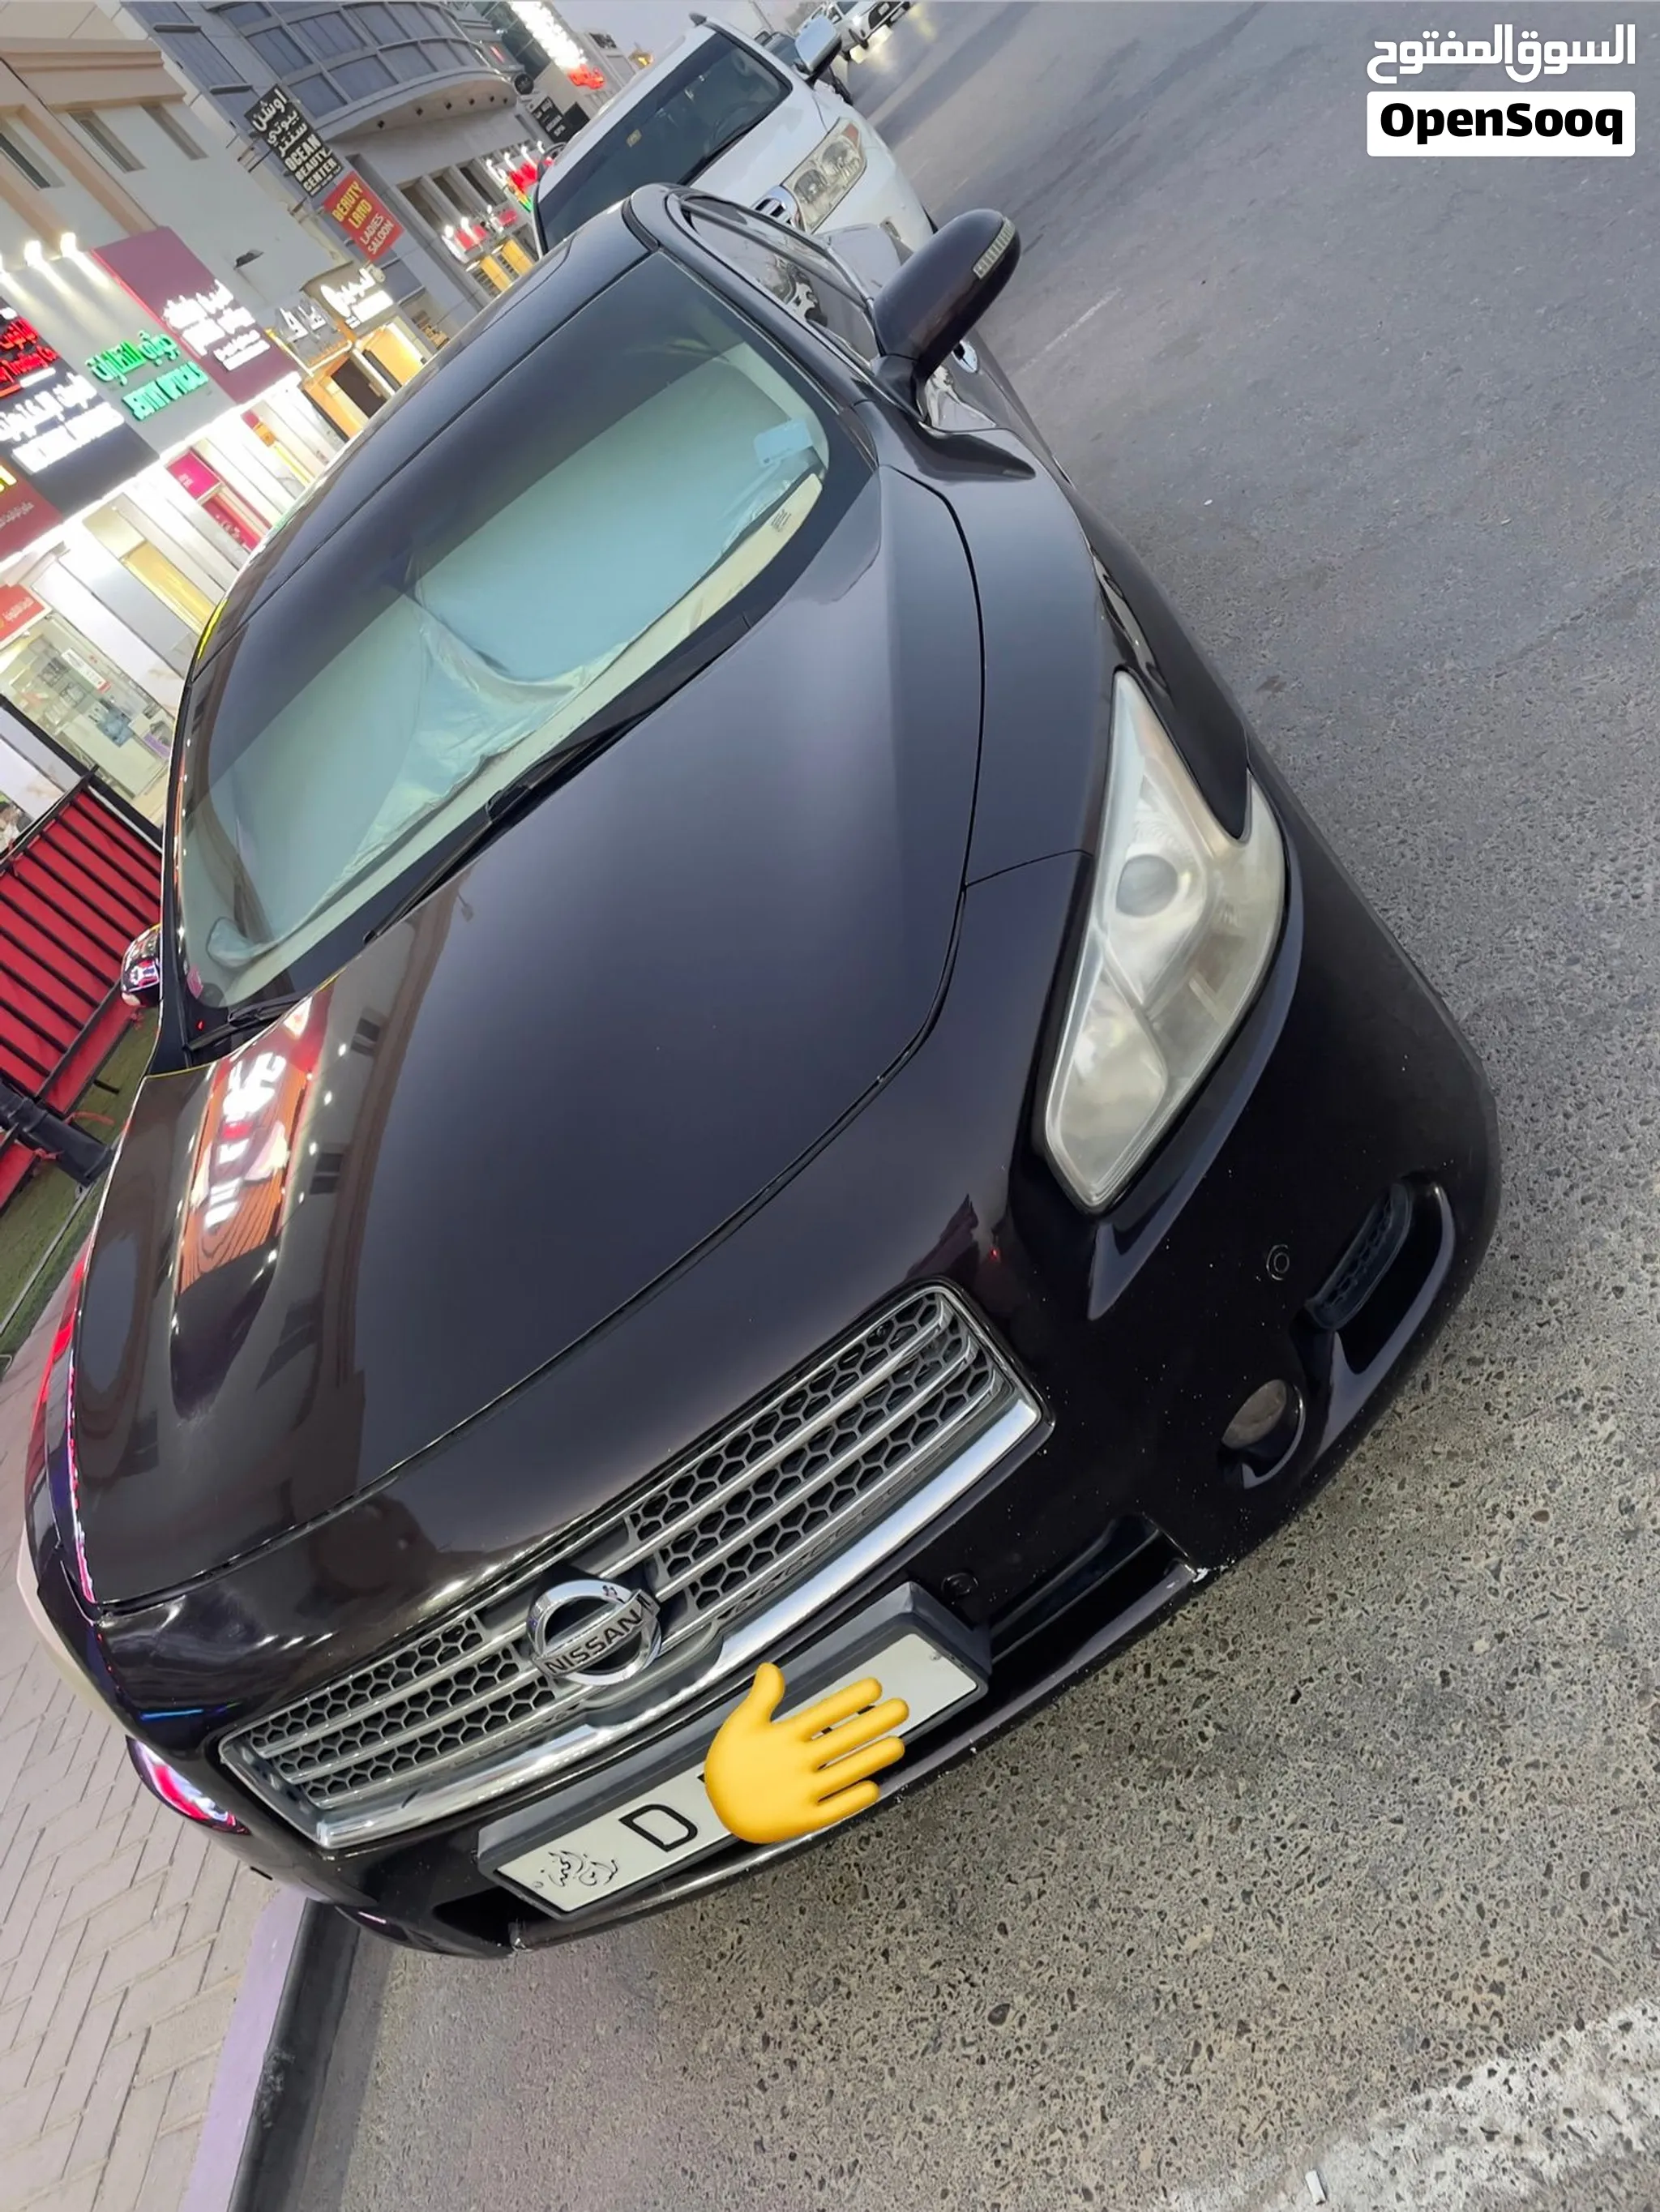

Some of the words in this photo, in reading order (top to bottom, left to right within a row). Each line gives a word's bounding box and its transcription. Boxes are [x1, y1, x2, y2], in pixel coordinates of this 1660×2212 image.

[285, 134, 322, 172] OCEAN
[294, 148, 329, 183] BEAUTY
[302, 159, 338, 192] CENTER
[332, 181, 364, 222] BEAUTY
[349, 199, 374, 229] LAND
[360, 212, 385, 245] LADIES
[367, 220, 395, 255] SALOON
[545, 1609, 644, 1675] NISSAN
[618, 1803, 698, 1853] D
